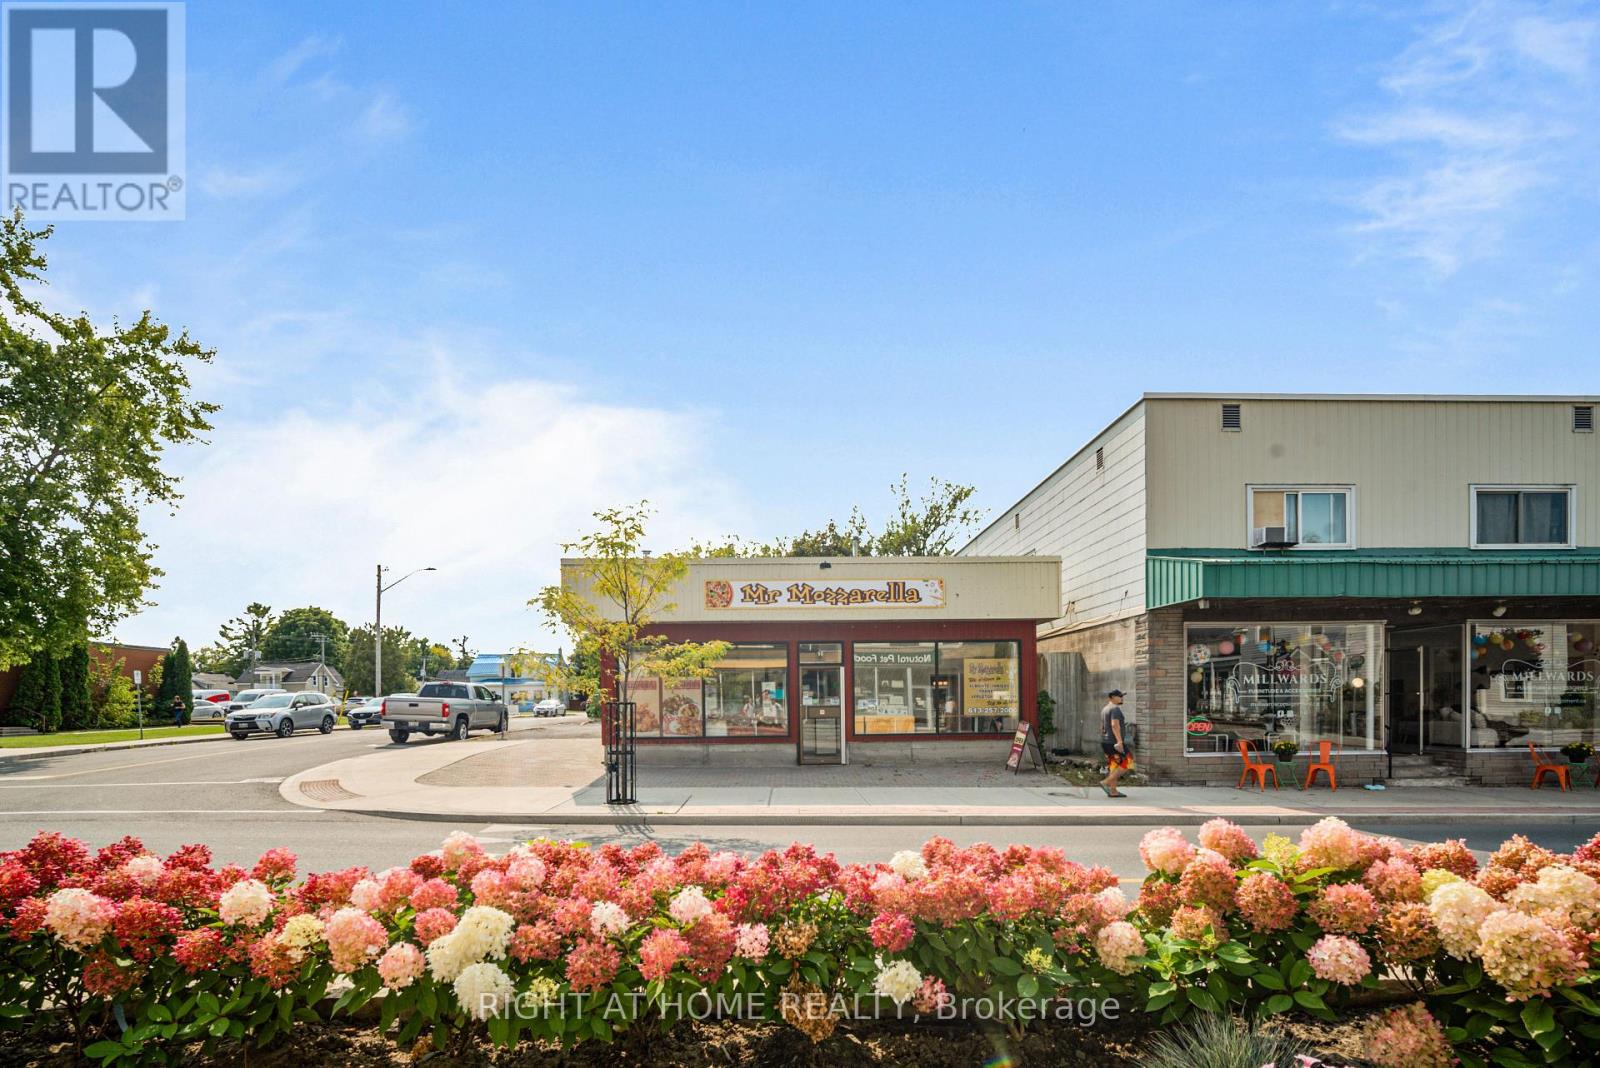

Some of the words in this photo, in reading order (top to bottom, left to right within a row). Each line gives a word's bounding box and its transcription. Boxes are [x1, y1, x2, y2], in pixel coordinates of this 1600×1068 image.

[741, 583, 782, 605] Mr
[787, 581, 923, 606] Mozzarella
[1243, 674, 1328, 685] MILLWARDS
[1186, 721, 1213, 732] OPEN
